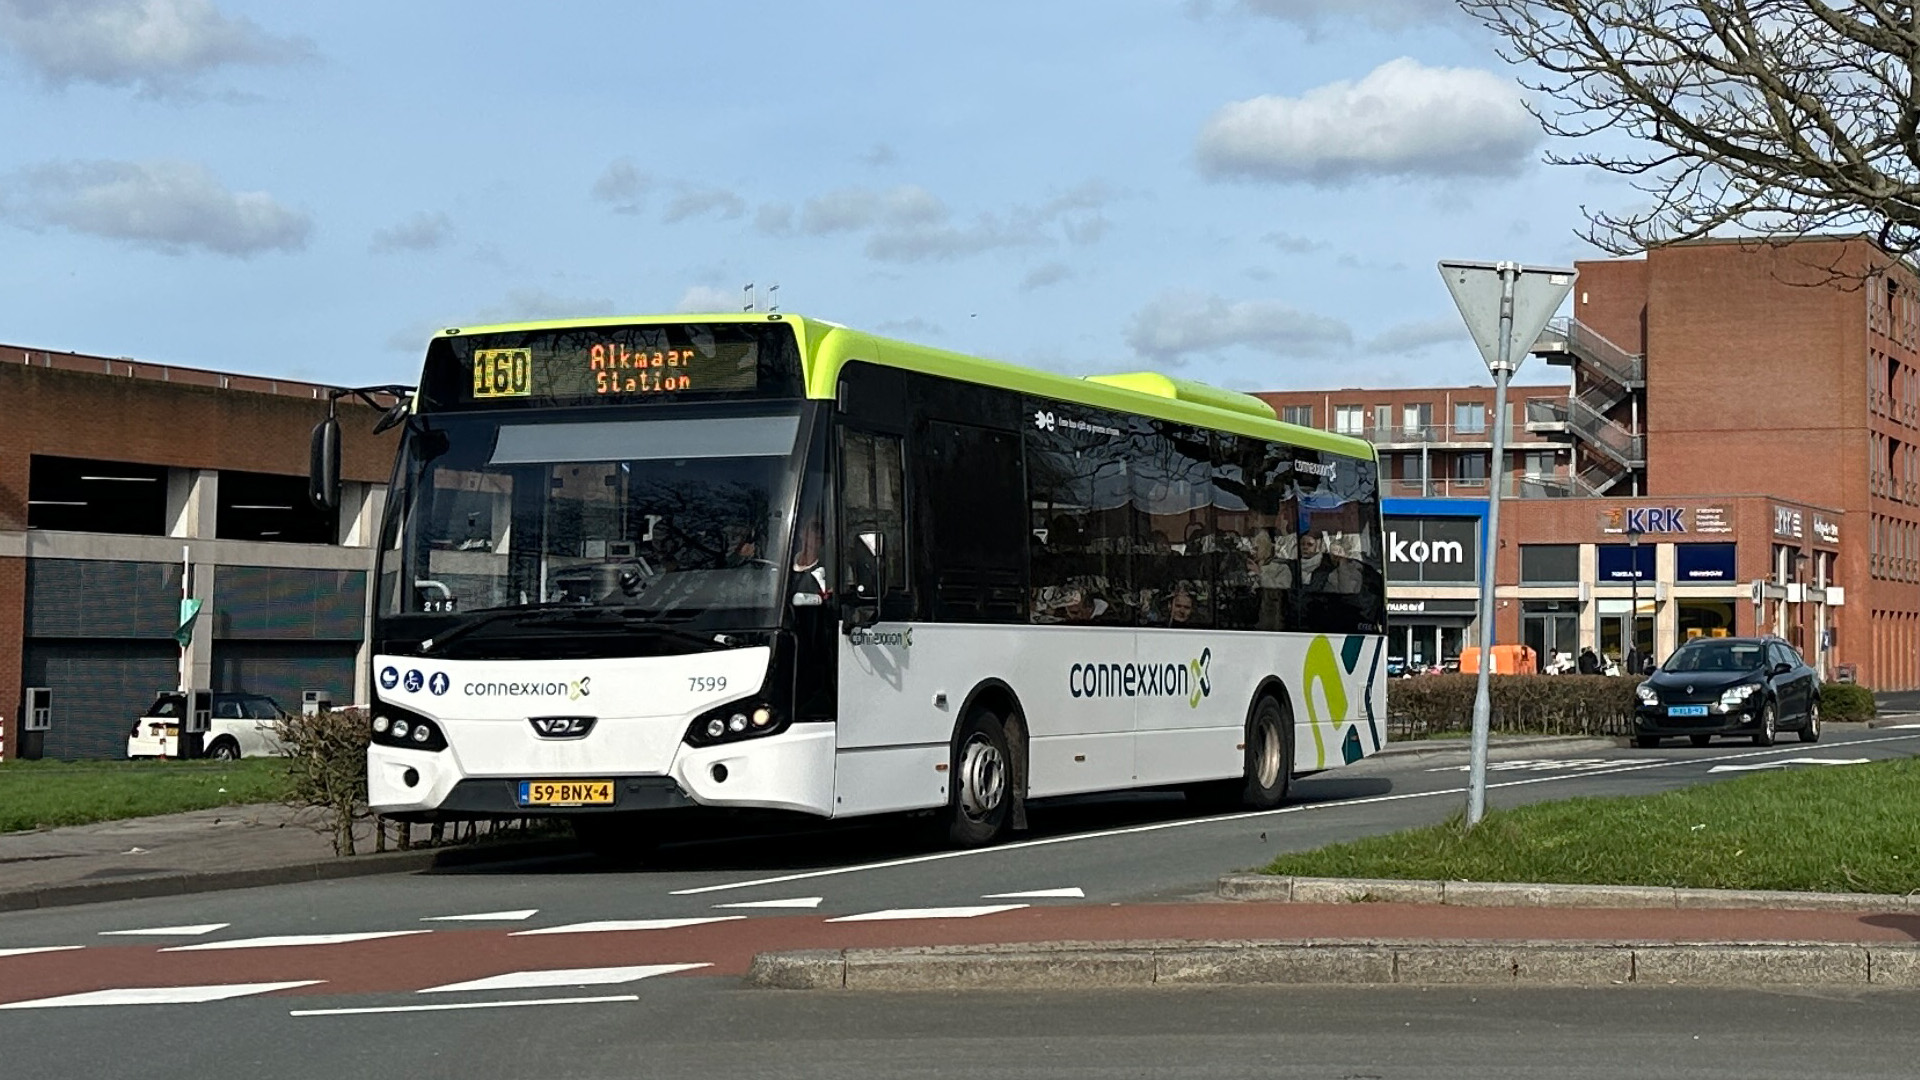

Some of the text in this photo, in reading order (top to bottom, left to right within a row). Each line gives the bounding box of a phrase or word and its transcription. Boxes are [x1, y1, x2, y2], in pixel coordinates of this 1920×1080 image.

[590, 344, 695, 370] Alkmaar
[476, 350, 529, 394] 160
[597, 370, 691, 393] Station
[1626, 507, 1687, 534] KRK
[424, 601, 453, 612] 215
[464, 679, 568, 697] connexxion
[688, 676, 727, 692] 7599
[1070, 663, 1188, 698] connexxion
[533, 784, 609, 801] 59-BNX-4
